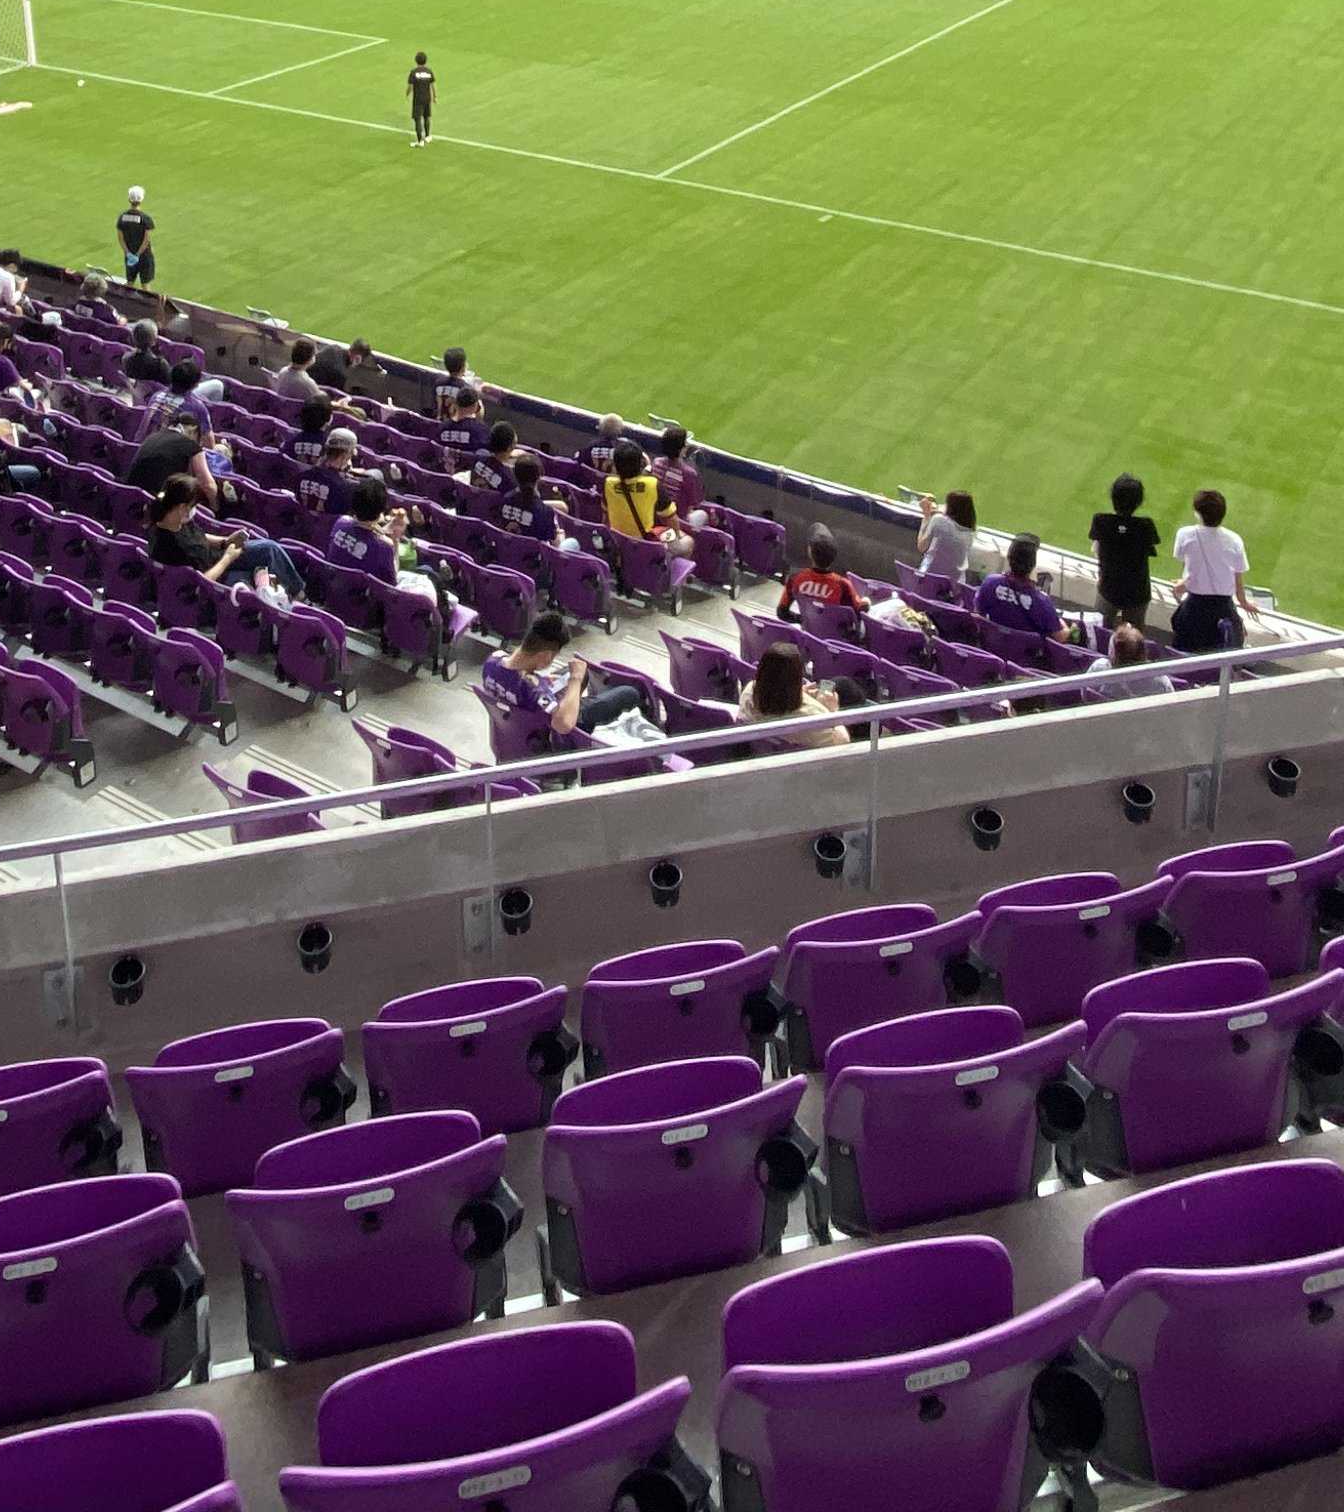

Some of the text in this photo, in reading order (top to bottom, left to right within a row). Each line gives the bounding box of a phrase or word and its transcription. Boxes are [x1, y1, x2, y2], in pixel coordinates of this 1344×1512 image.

[440, 430, 470, 444] 任天堂
[475, 461, 503, 489] 任天堂
[300, 479, 330, 501] 任天堂
[502, 504, 534, 527] 任天堂
[334, 529, 368, 560] 任天堂
[798, 579, 834, 599] au
